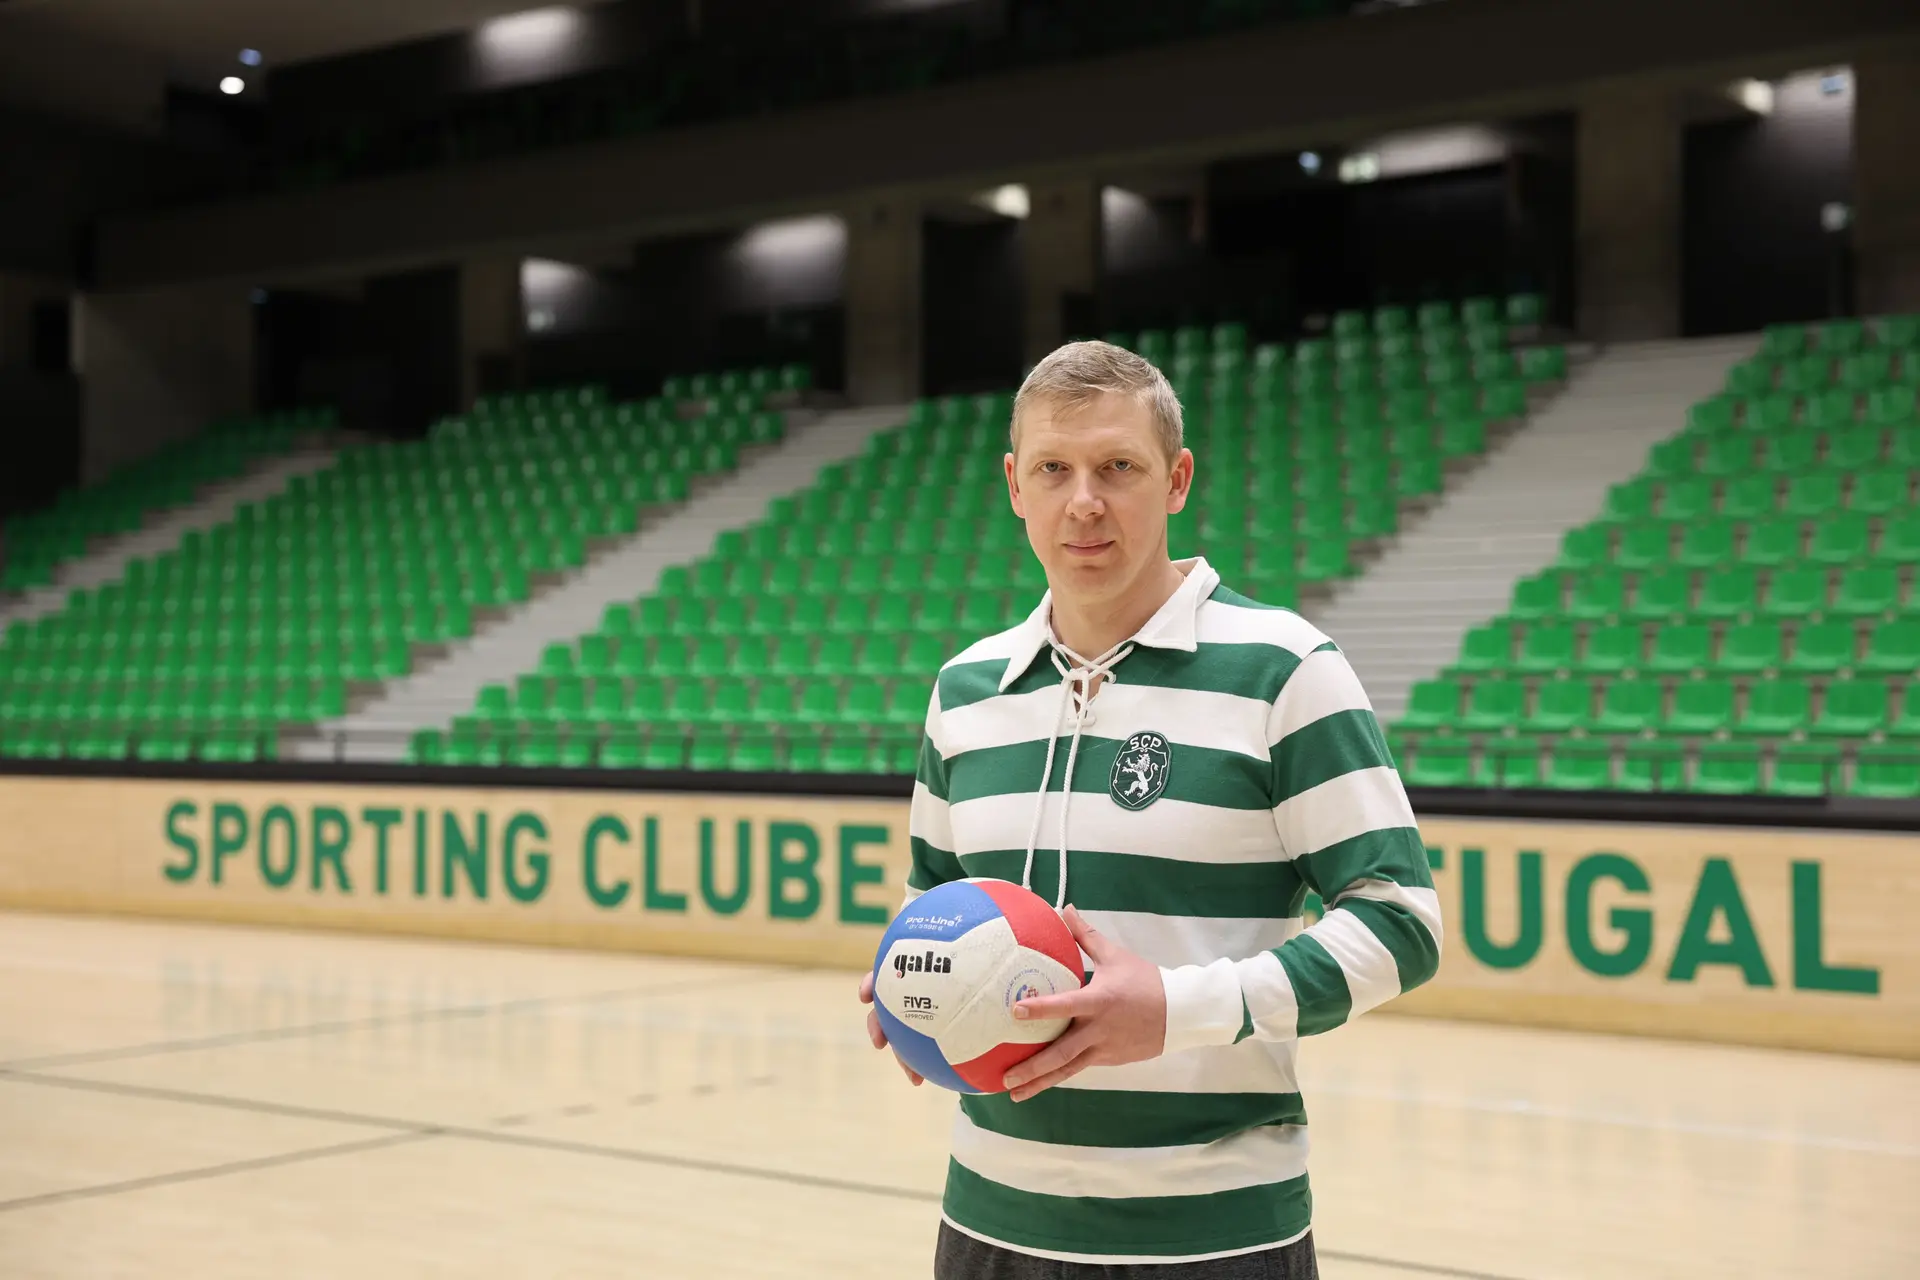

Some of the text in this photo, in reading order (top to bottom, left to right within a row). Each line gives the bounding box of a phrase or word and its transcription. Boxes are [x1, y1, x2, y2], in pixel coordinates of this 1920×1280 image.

[1129, 734, 1162, 750] SCP
[162, 800, 1880, 995] SPORTING CLUBE UGAL
[894, 951, 952, 979] gala
[903, 996, 932, 1009] FIVB
